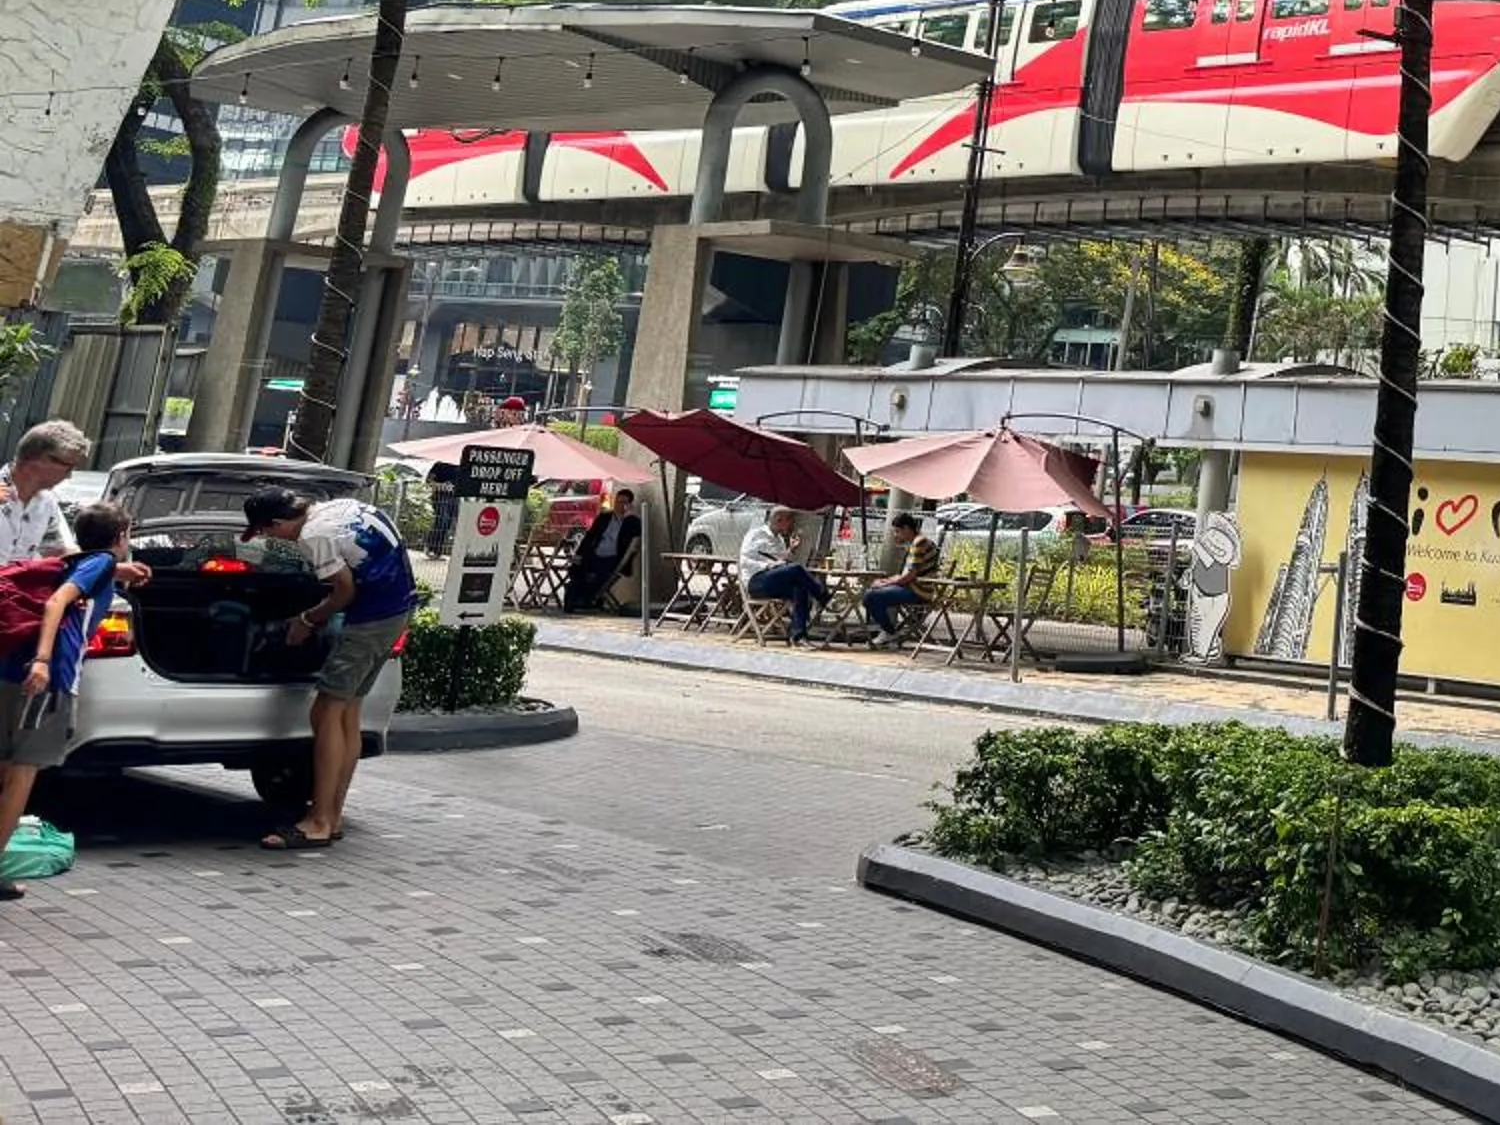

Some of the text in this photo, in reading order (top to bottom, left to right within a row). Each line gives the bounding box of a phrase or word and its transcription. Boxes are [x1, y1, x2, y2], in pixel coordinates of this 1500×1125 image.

[1263, 18, 1332, 42] rapidKL
[469, 449, 529, 466] PASSENGER
[471, 466, 523, 481] DROP OFF
[480, 482, 509, 495] HERE
[1407, 543, 1461, 563] Welcome
[1464, 549, 1477, 563] to
